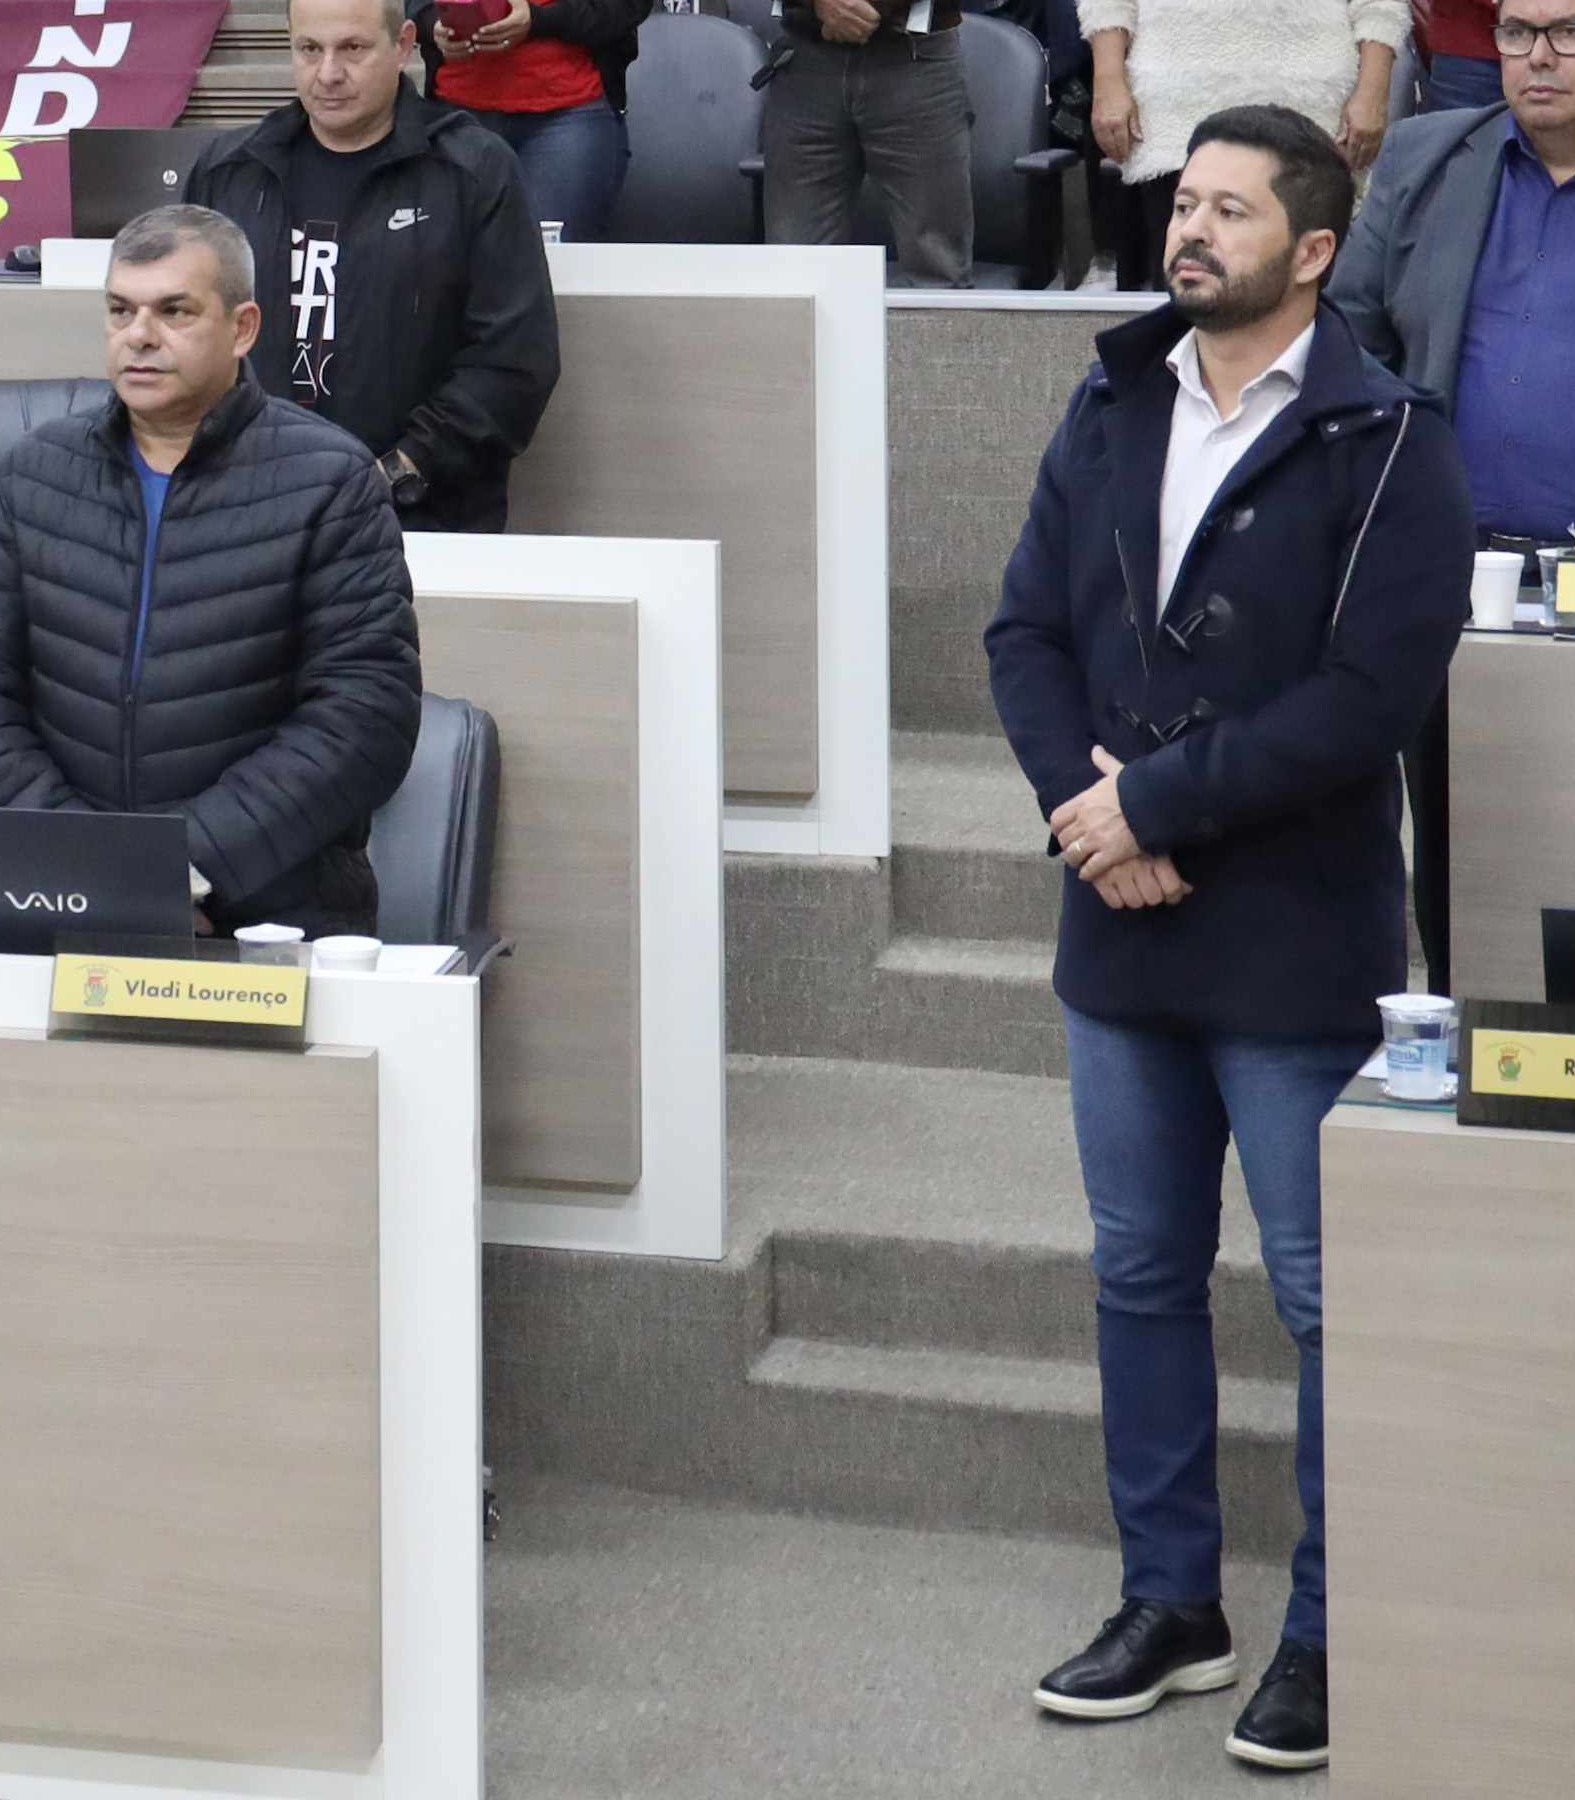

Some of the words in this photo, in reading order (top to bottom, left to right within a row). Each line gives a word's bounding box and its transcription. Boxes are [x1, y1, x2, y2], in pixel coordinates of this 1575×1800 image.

[4, 891, 88, 913] VAIO
[125, 979, 181, 999] Vladi
[188, 983, 287, 1009] Lourenço
